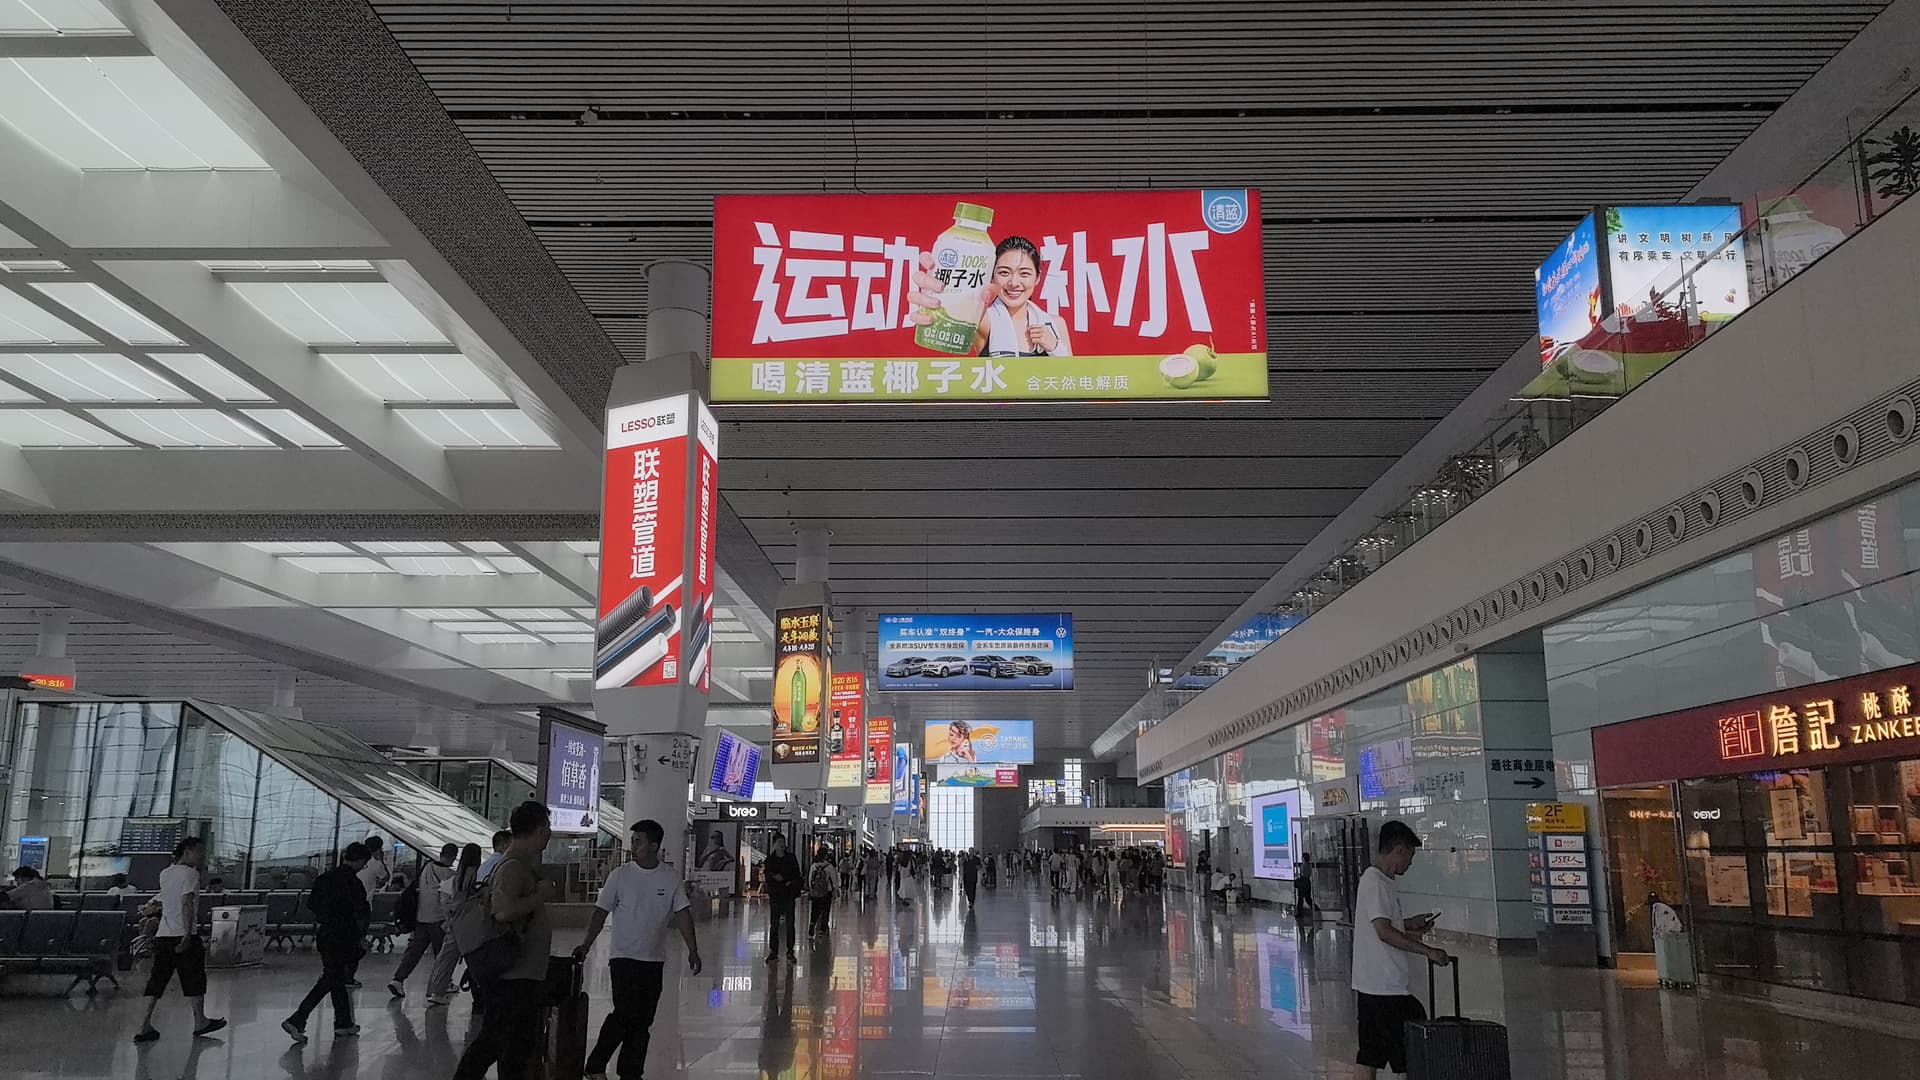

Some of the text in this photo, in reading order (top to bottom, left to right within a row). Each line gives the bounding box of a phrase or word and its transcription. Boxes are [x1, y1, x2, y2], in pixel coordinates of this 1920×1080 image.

[961, 254, 988, 269] 100%
[752, 221, 920, 344] 运动
[1040, 222, 1211, 338] 补水
[934, 268, 986, 289] 椰子水
[751, 361, 1008, 395] 喝清蓝椰子水
[1025, 375, 1129, 391] 含天然电解质
[621, 416, 656, 433] LESSO
[629, 447, 661, 580] 联塑管道
[1862, 685, 1912, 721] 桃酥
[1768, 699, 1841, 758] 詹記
[728, 805, 759, 818] breo
[1544, 804, 1564, 817] 2F
